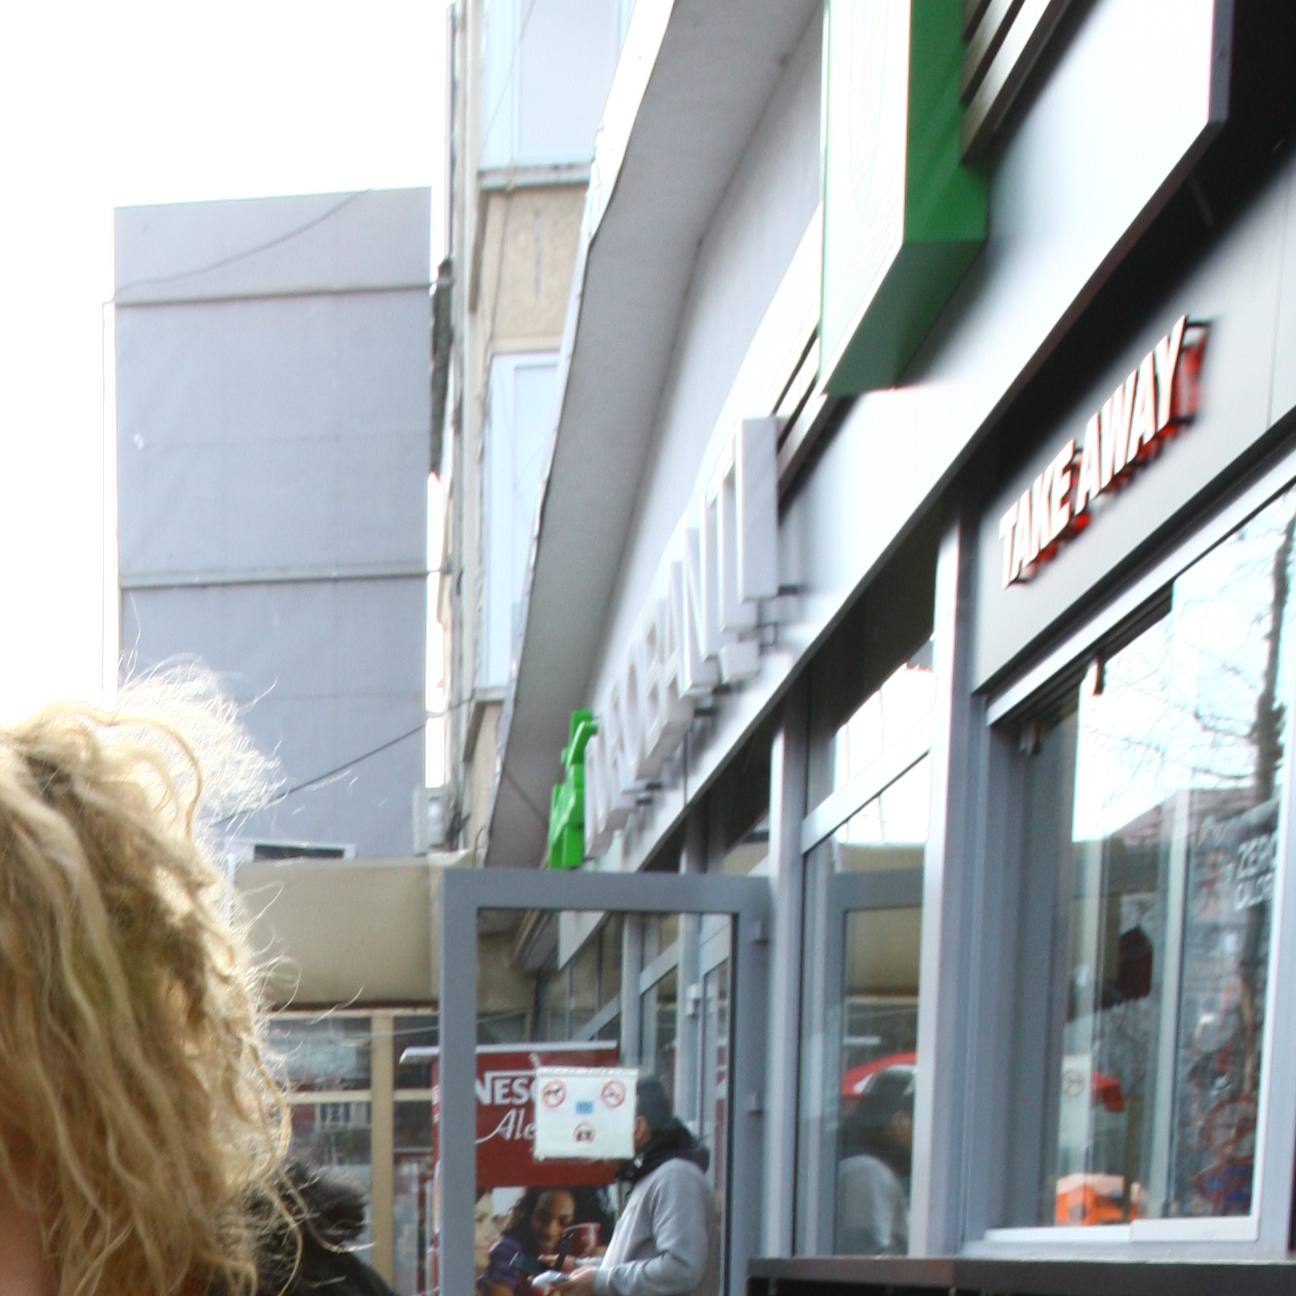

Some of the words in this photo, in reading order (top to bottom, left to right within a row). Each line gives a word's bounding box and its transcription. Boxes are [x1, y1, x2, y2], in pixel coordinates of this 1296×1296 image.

[998, 438, 1075, 588] TAKE
[1074, 314, 1188, 515] AWAY
[475, 1108, 536, 1144] Ale
